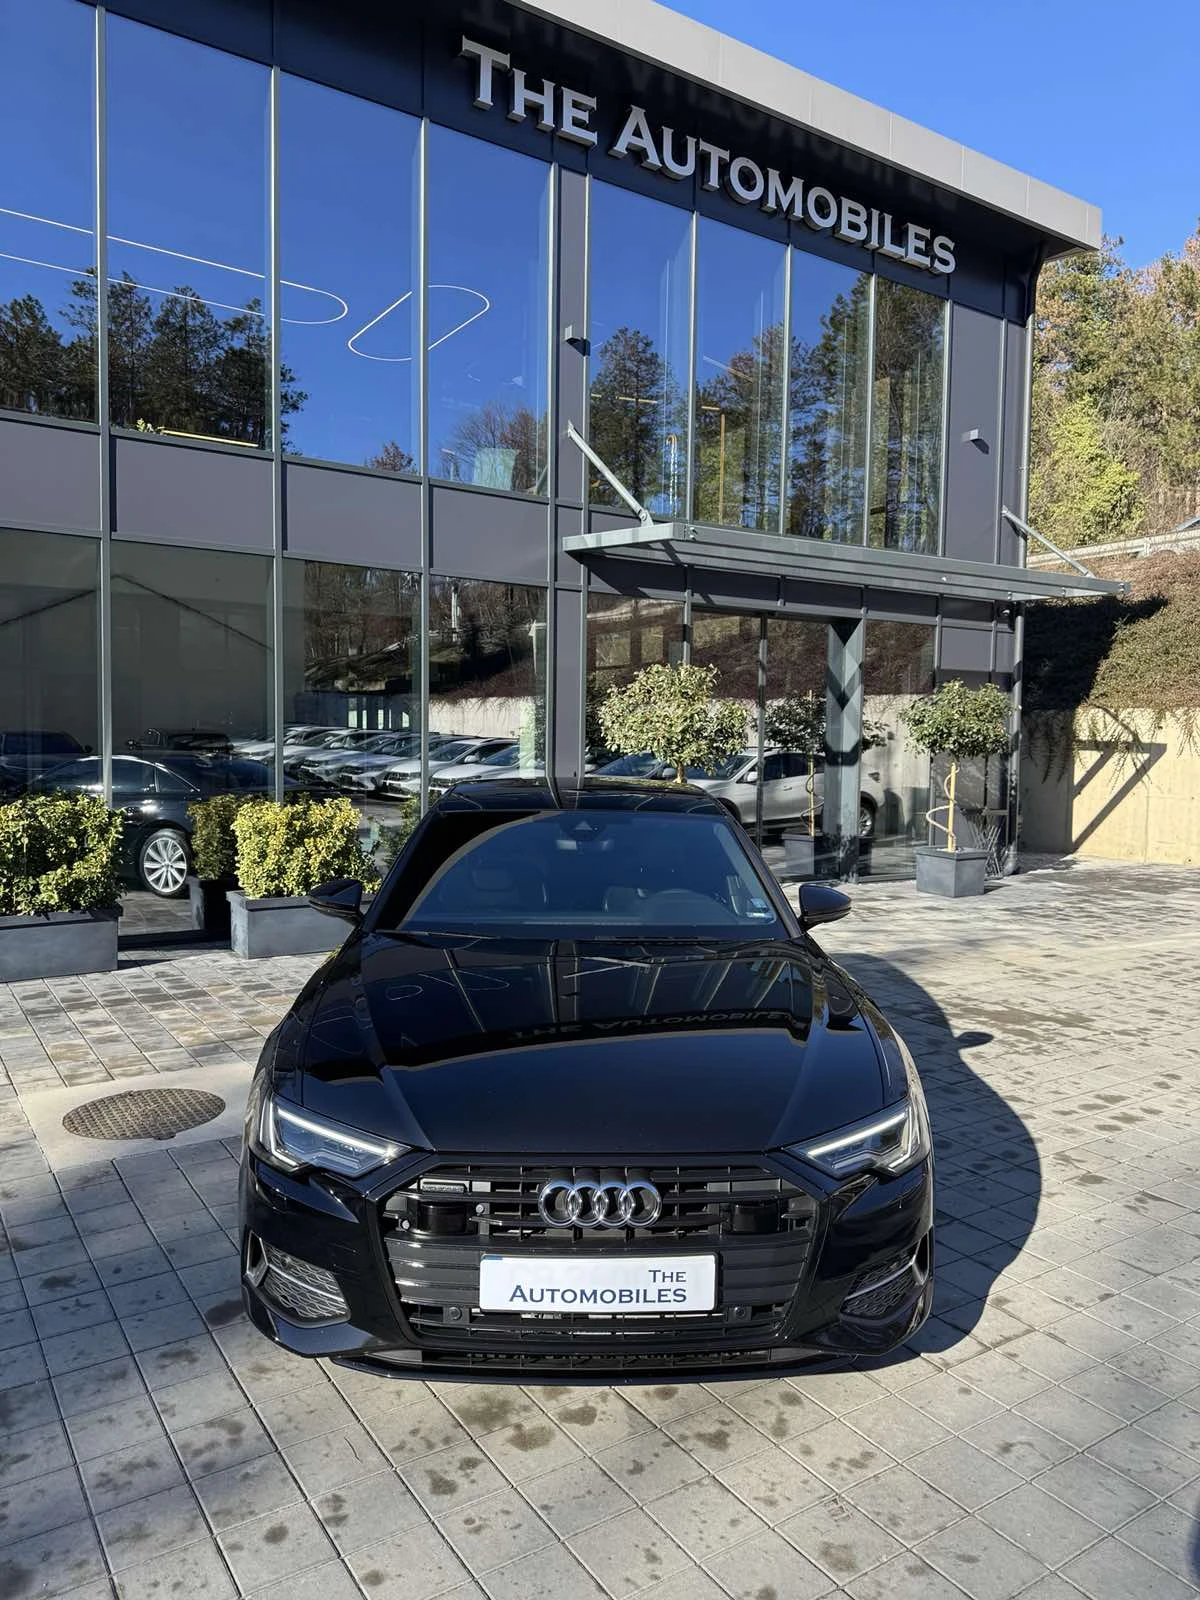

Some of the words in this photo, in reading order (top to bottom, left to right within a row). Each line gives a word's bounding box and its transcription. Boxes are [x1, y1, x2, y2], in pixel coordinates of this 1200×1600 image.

[459, 35, 598, 146] THE
[608, 104, 957, 275] AUTOMOBILES
[648, 1269, 687, 1283] THE
[509, 1285, 687, 1304] AUTOMOBILES
